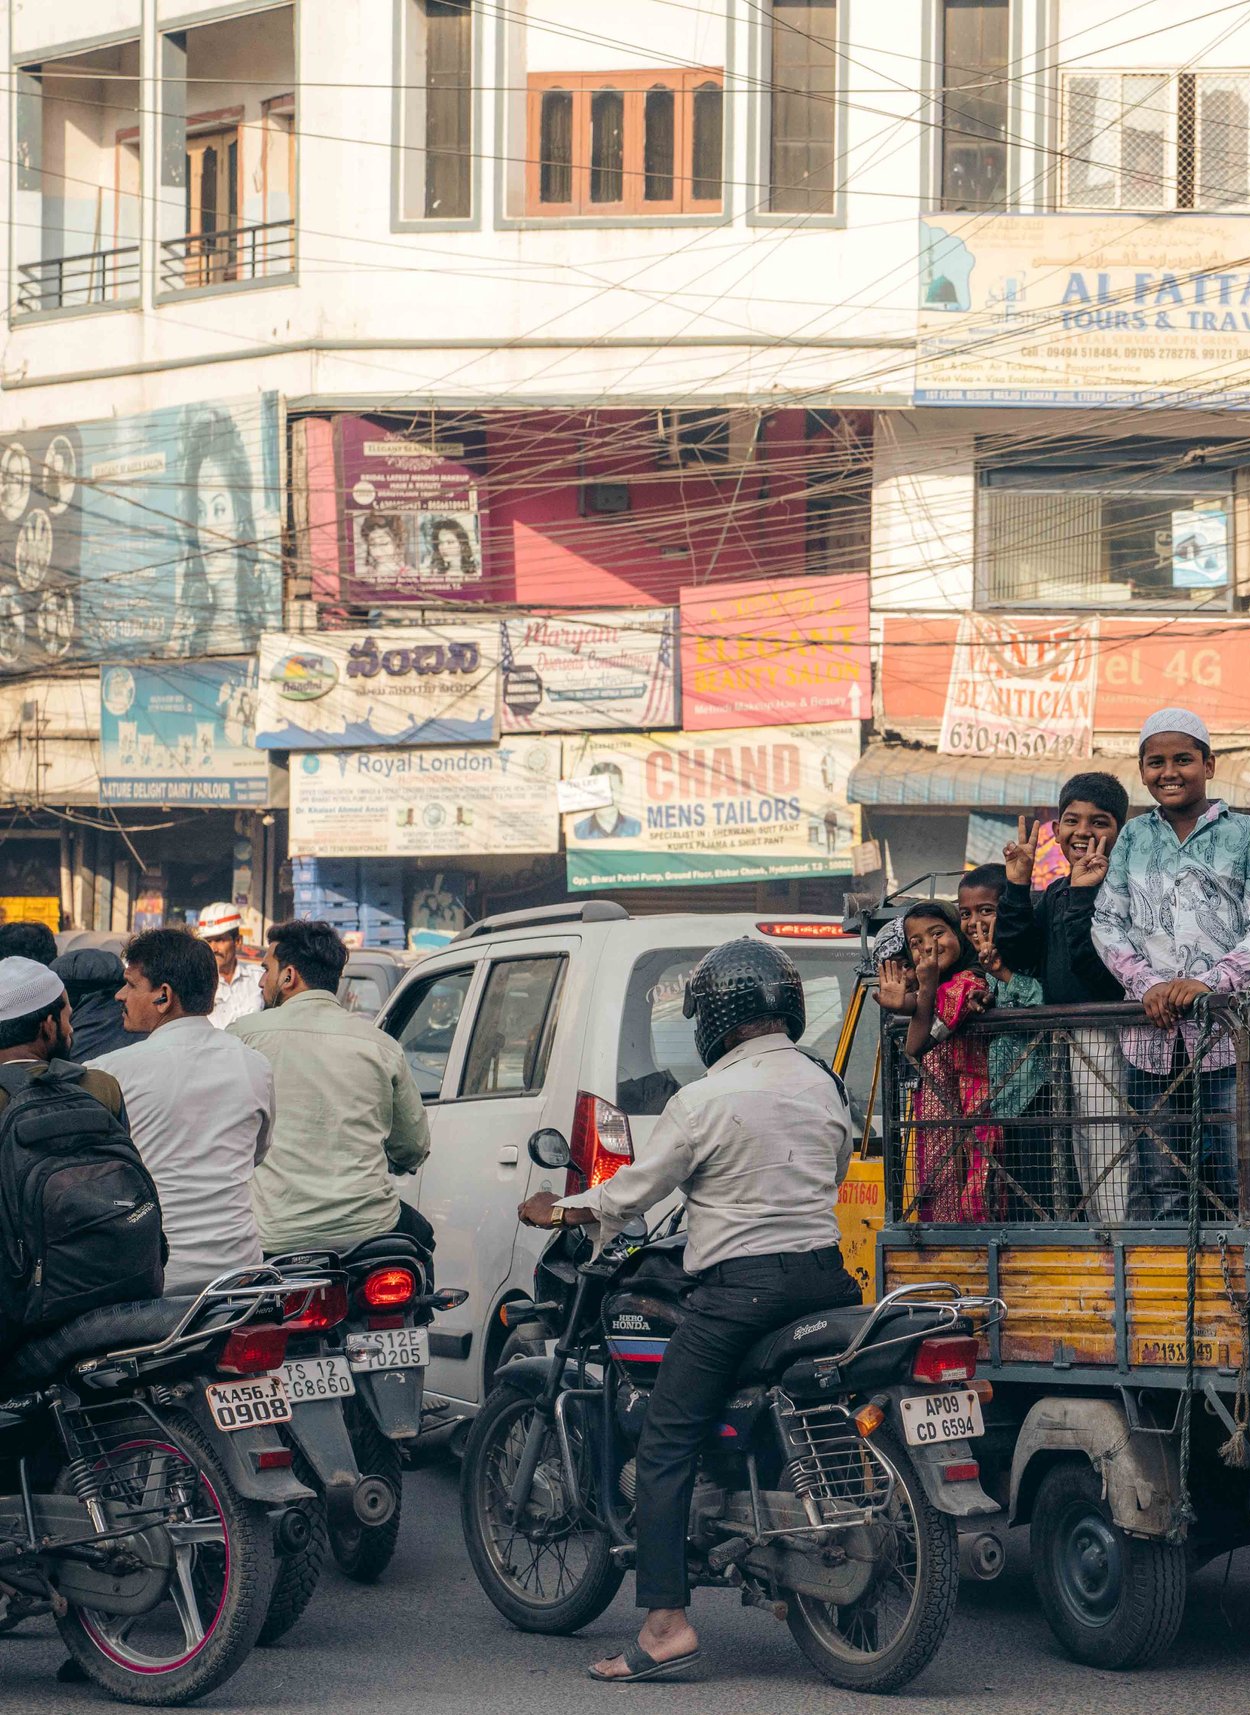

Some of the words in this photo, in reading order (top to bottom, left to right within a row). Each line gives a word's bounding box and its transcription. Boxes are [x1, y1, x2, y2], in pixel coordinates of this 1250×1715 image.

[1061, 272, 1120, 305] AL
[1061, 310, 1146, 332] TOURS
[1154, 311, 1176, 331] &
[1112, 335, 1161, 346] SERVICE
[1047, 347, 1078, 359] 09494
[1124, 348, 1156, 359] 09705
[1202, 348, 1233, 360] 99121
[1108, 364, 1140, 373] Service
[525, 622, 619, 655] Maryam
[696, 626, 857, 664] ELEGANT
[538, 652, 584, 672] Overseas
[1162, 648, 1223, 686] 4G
[694, 666, 780, 693] BEAUTY
[785, 661, 860, 687] SALON
[954, 679, 1091, 721] BEAUTICIAN
[358, 752, 413, 778] Royal
[420, 752, 494, 773] London
[645, 744, 801, 802] CHAND
[134, 782, 165, 799] DELIGHT
[168, 782, 191, 799] DAIRY
[194, 782, 230, 799] PARLOUR
[647, 804, 705, 830] MENS
[712, 797, 801, 826] TAILORS
[650, 830, 695, 841] SPECIALIST
[780, 824, 799, 833] PANT
[667, 842, 693, 851] KURTA
[696, 840, 728, 850] PAJAMA
[739, 838, 763, 847] SHIRT
[765, 836, 784, 846] PANT
[591, 874, 616, 884] Bharat
[617, 873, 640, 883] Petrol
[665, 870, 692, 880] Ground
[255, 1306, 274, 1315] Hero
[618, 1314, 644, 1322] HERO
[612, 1320, 651, 1331] HONDA
[286, 1363, 307, 1382] TS
[317, 1360, 338, 1378] 12
[284, 1376, 351, 1400] EG8660
[217, 1399, 288, 1427] 0908
[926, 1395, 960, 1417] AP09
[916, 1421, 937, 1441] CD
[941, 1415, 975, 1438] 6594
